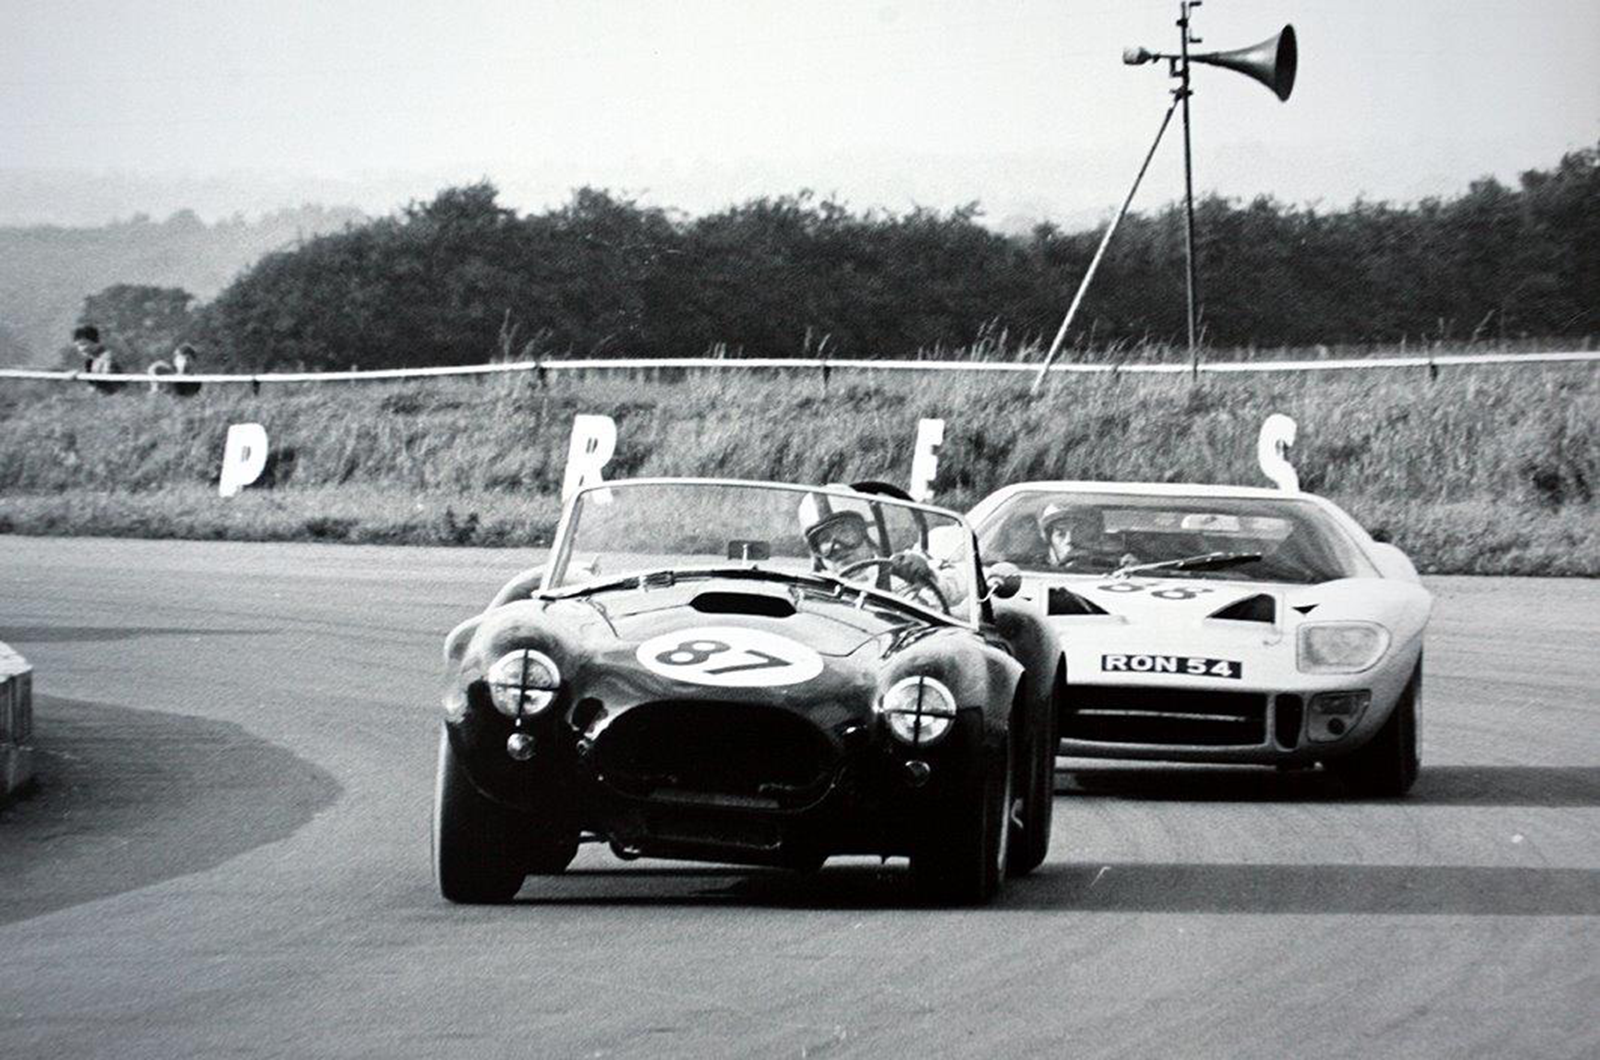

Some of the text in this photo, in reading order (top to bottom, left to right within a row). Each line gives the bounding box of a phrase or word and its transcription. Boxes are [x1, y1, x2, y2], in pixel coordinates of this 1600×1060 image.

[655, 640, 793, 675] 87
[1105, 655, 1233, 677] RON 54
